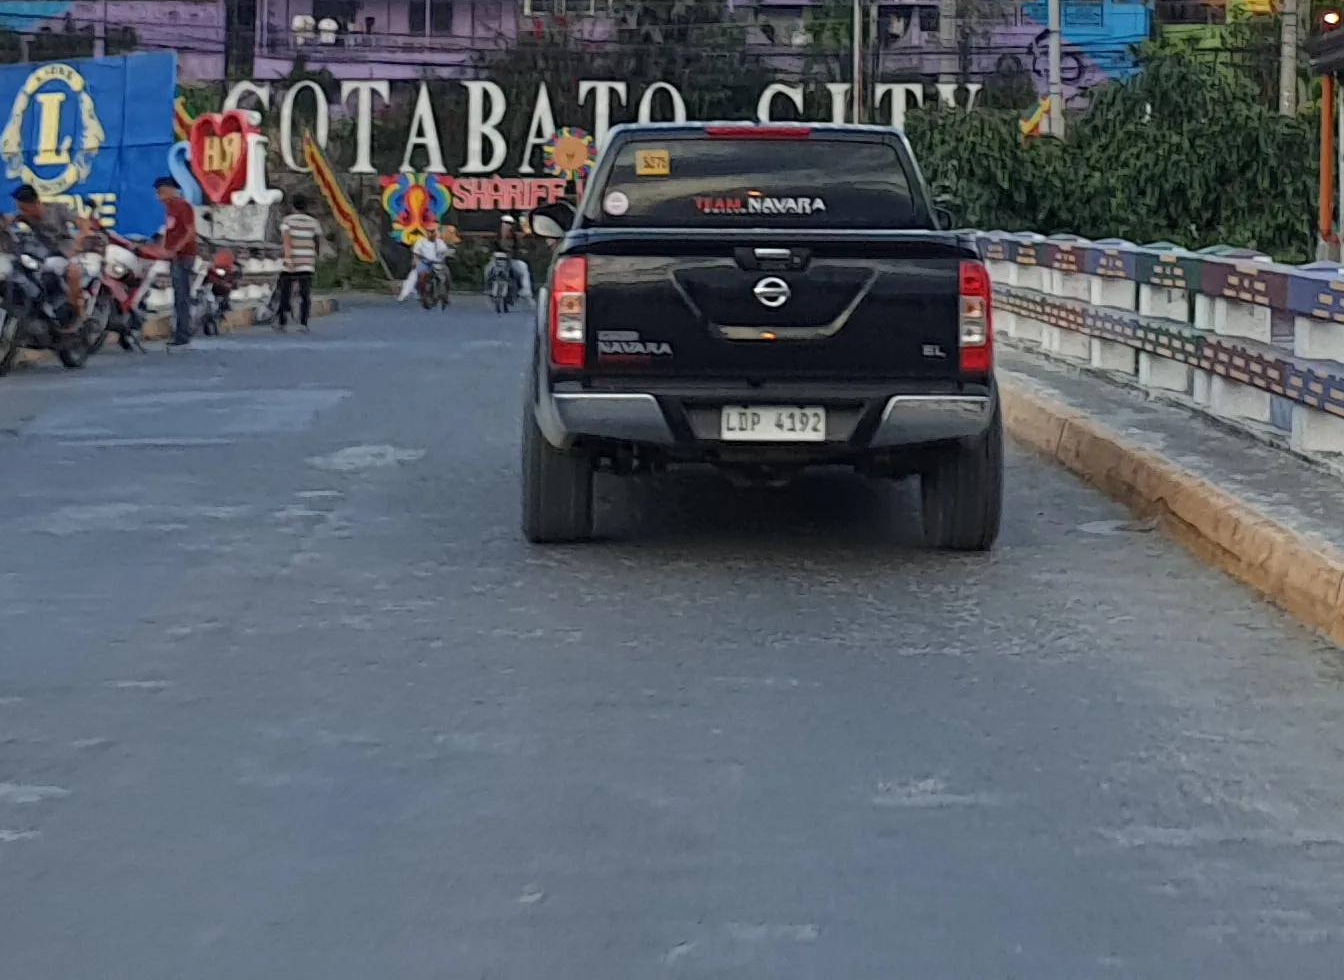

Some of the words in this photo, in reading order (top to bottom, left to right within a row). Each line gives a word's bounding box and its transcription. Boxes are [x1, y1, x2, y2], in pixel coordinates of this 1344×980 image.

[450, 175, 568, 210] SHARIFF
[747, 197, 827, 215] NAVARA
[597, 341, 674, 357] NAVARA
[774, 412, 822, 433] 4192
